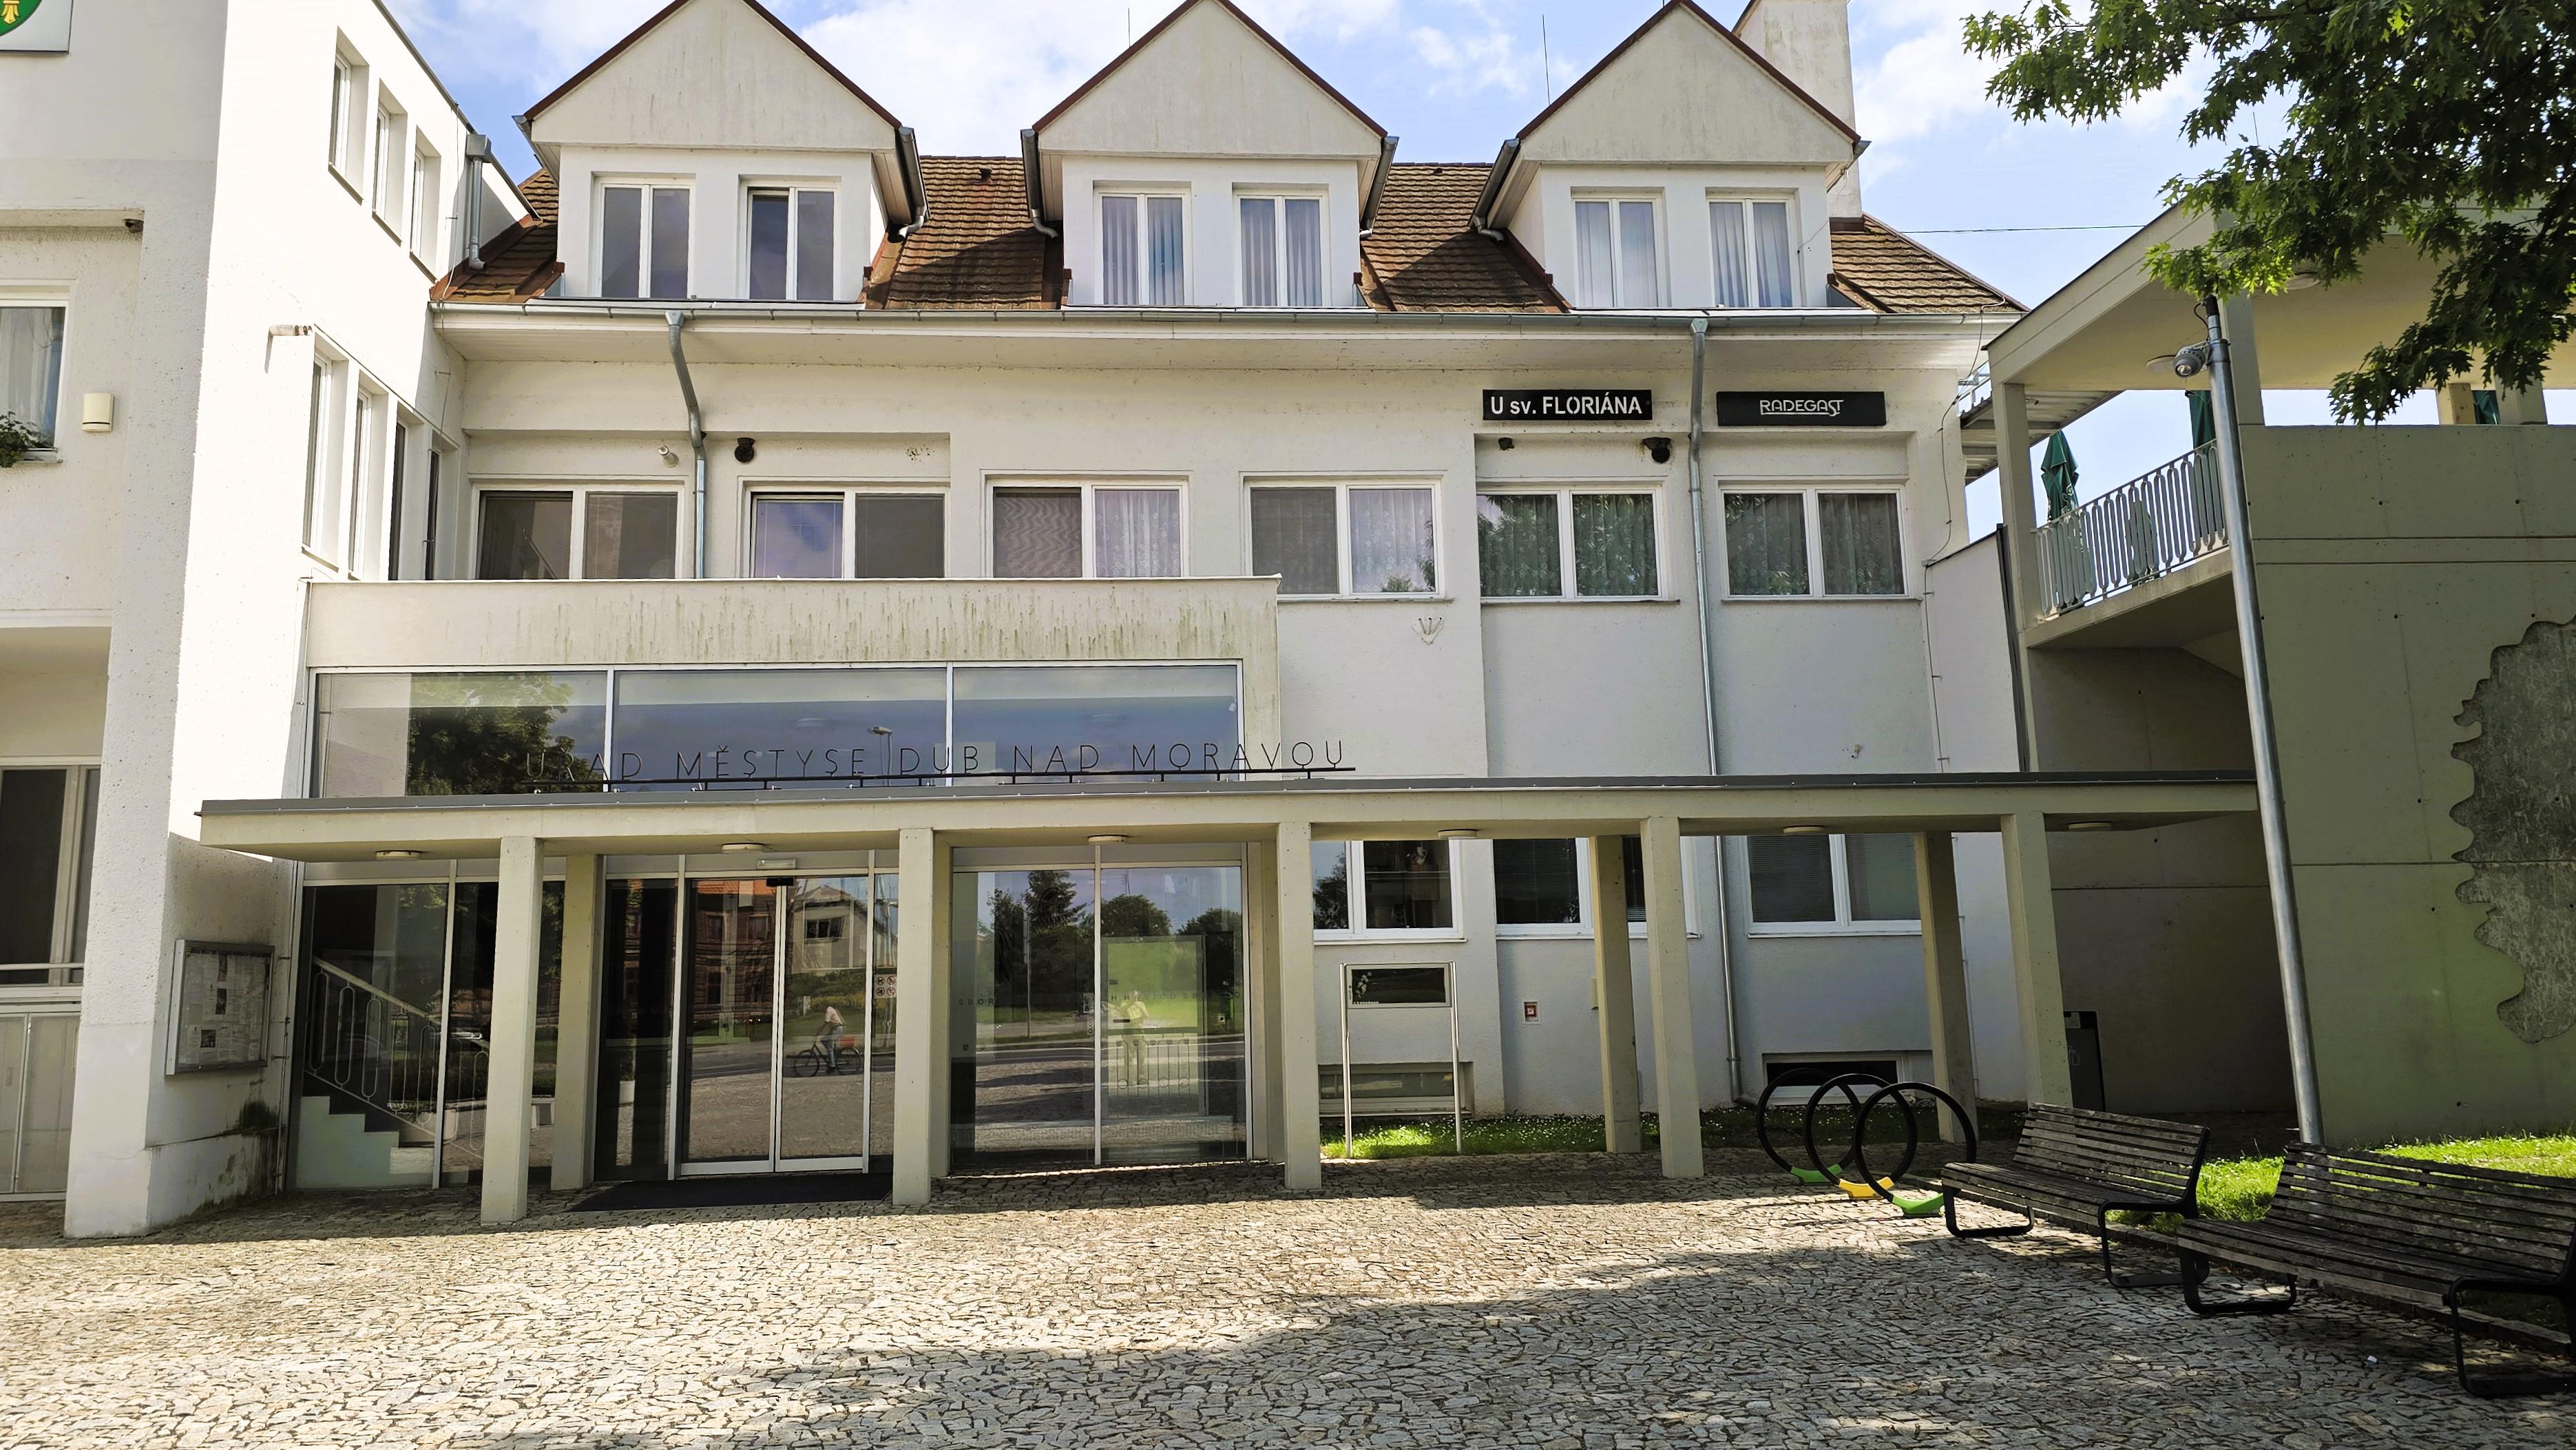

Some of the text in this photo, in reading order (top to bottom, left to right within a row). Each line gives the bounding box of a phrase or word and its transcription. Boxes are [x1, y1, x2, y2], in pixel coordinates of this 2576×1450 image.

[1490, 392, 1643, 415] U sv. FLORIÁNA
[1759, 399, 1845, 417] RADEGAST
[676, 744, 865, 780] MĚSTYSE
[900, 746, 979, 776] DUB
[1013, 744, 1100, 773] NAD
[1132, 739, 1343, 772] MORAVOU
